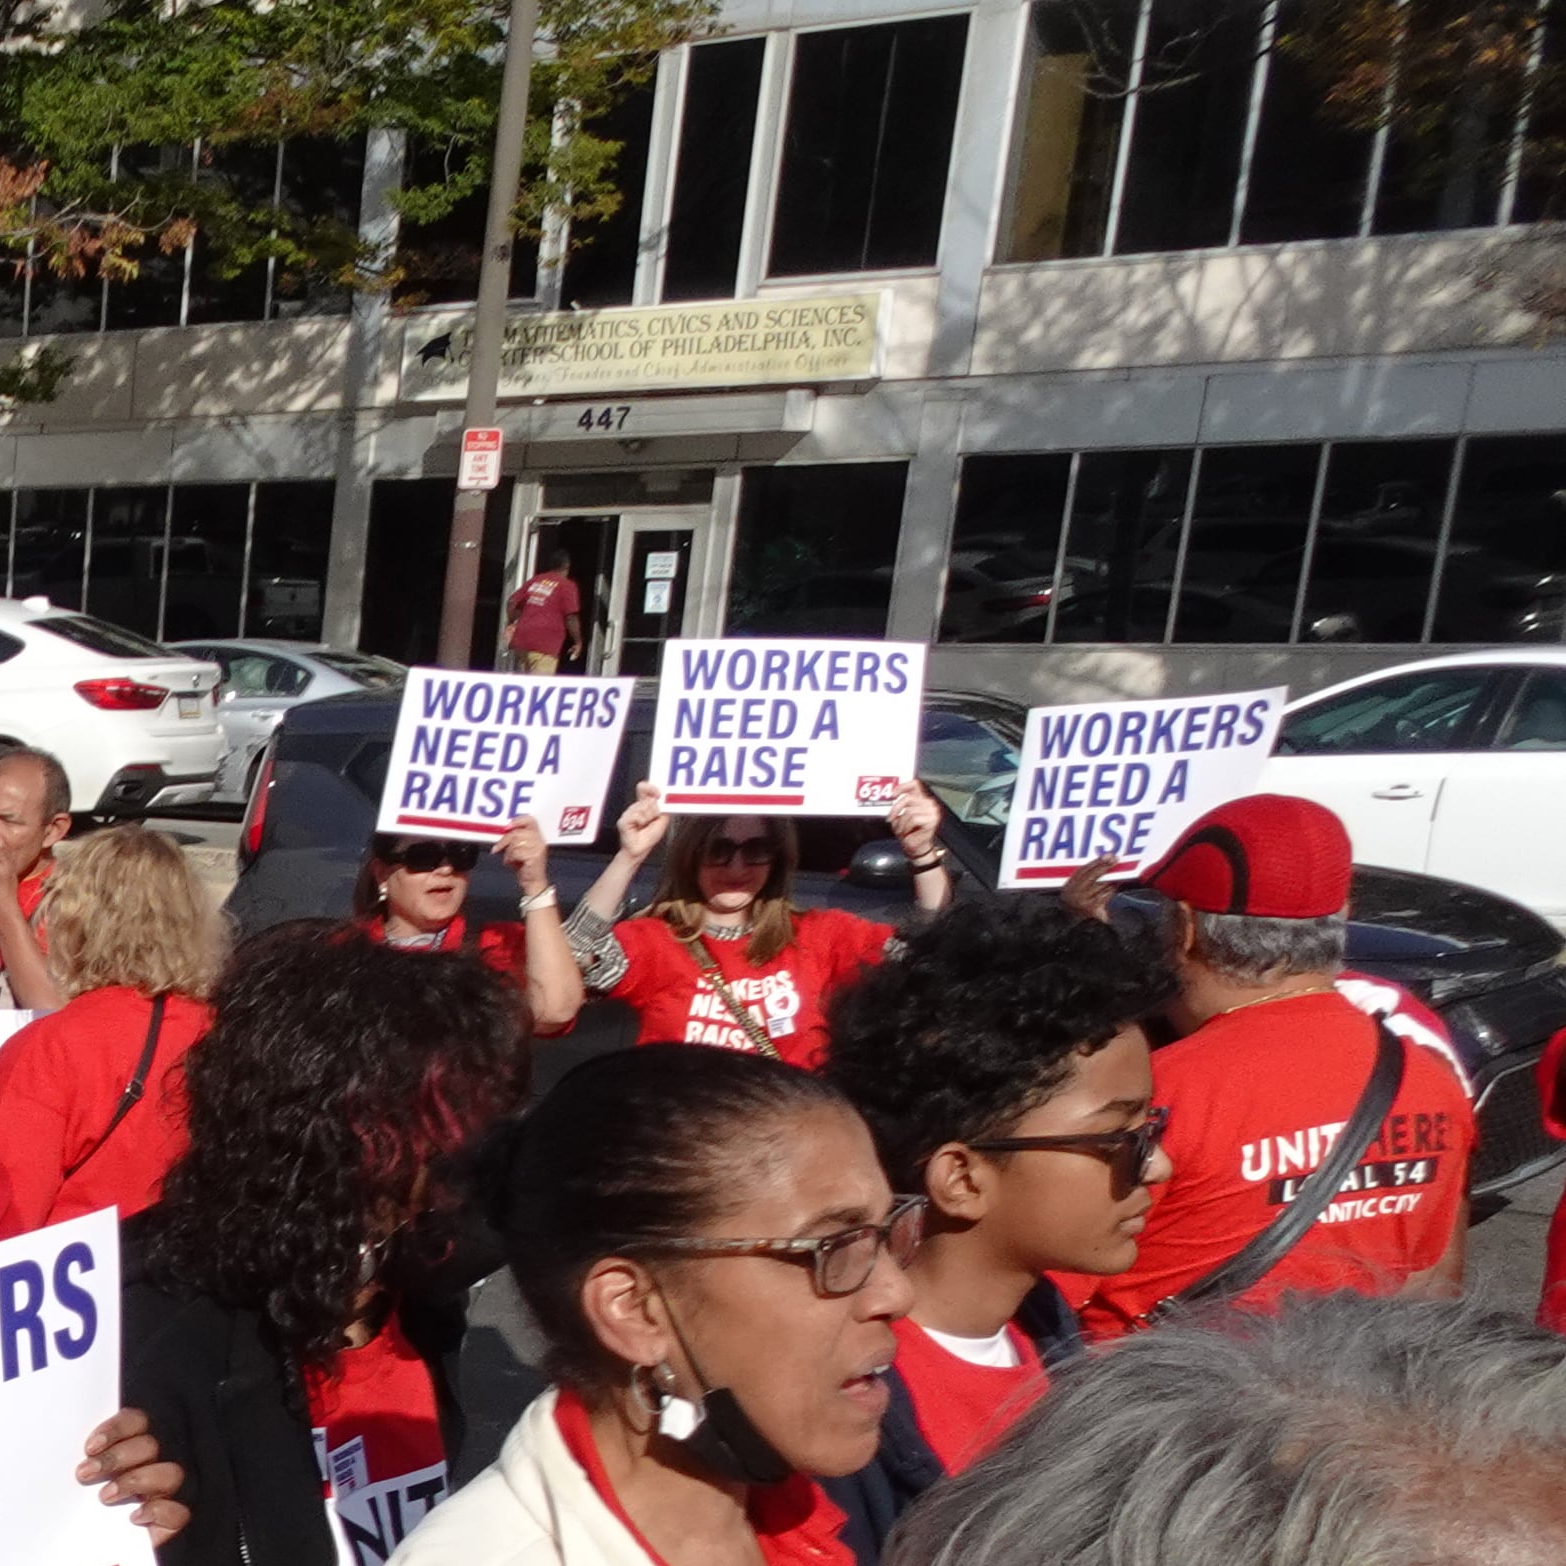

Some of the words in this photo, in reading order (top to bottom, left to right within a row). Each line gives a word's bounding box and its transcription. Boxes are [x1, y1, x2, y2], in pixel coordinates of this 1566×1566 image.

[648, 313, 712, 336] CIVICS
[717, 310, 759, 332] AND
[764, 304, 866, 329] SCIENCES
[548, 342, 624, 364] SCHOOL
[630, 338, 654, 359] OF
[661, 331, 817, 357] PHILADELPHIA,
[823, 327, 863, 348] INC.
[578, 406, 631, 432] 447
[682, 648, 910, 695] WORKERS
[422, 678, 621, 729] WORKERS
[673, 697, 799, 740] NEED
[809, 699, 840, 740] A
[409, 725, 529, 774] NEED
[537, 734, 562, 775] A
[1039, 699, 1271, 760] WORKERS
[667, 746, 809, 788] RAISE
[1027, 762, 1152, 812] NEED
[1156, 759, 1190, 806] A
[399, 769, 536, 820] RAISE
[858, 782, 894, 802] 634
[1018, 811, 1157, 862] RAISE
[1393, 1159, 1429, 1186] 54
